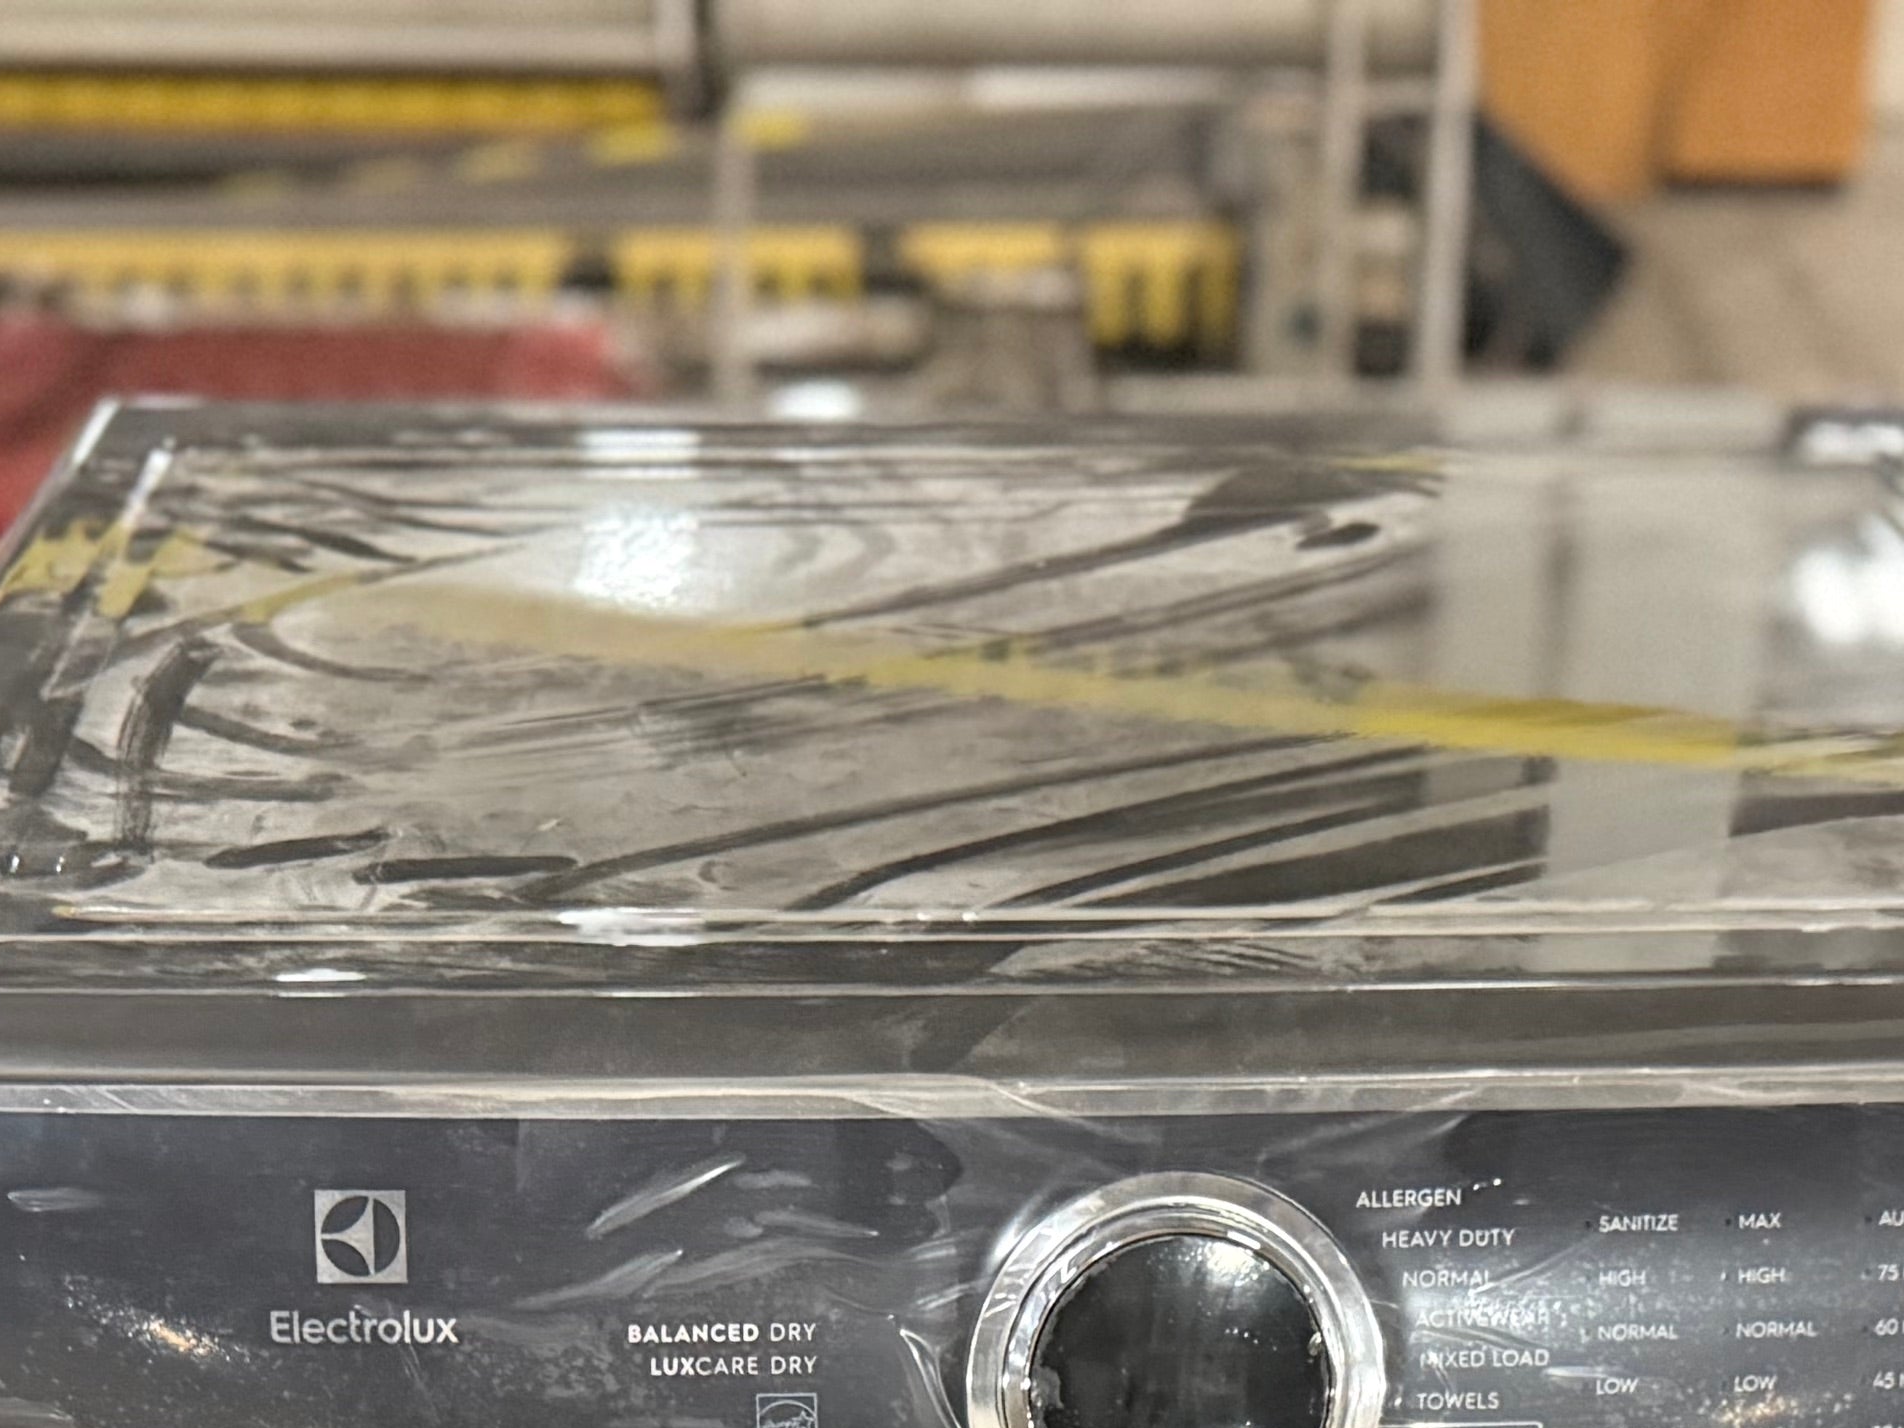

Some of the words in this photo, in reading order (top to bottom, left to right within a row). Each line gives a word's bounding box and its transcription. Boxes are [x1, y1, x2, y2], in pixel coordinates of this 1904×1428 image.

[1356, 1189, 1461, 1208] ALLERGEN
[1599, 1214, 1679, 1232] SANITIZE
[1739, 1212, 1782, 1229] MAX
[1382, 1230, 1452, 1249] HEAVY
[1459, 1228, 1515, 1247] DUTY
[1402, 1270, 1491, 1288] NORMAL
[1599, 1270, 1646, 1287] HIGH
[1738, 1266, 1786, 1284] HIGH
[1877, 1264, 1898, 1281] 75
[270, 1310, 460, 1344] Electrolux
[1415, 1309, 1549, 1328] ACTIVEWEAR
[1874, 1318, 1898, 1336] 60
[628, 1324, 759, 1344] BALANCED
[770, 1323, 817, 1341] DRY
[1597, 1324, 1678, 1341] NORMAL
[1736, 1320, 1818, 1339] NORMAL
[650, 1357, 759, 1376] LUXCARE
[770, 1356, 817, 1374] DRY
[1420, 1350, 1486, 1369] MIXED
[1492, 1349, 1549, 1367] LOAD
[1596, 1376, 1640, 1395] LOW
[1734, 1375, 1778, 1392] LOW
[1872, 1372, 1895, 1389] 45
[1417, 1392, 1499, 1410] TOWELS
